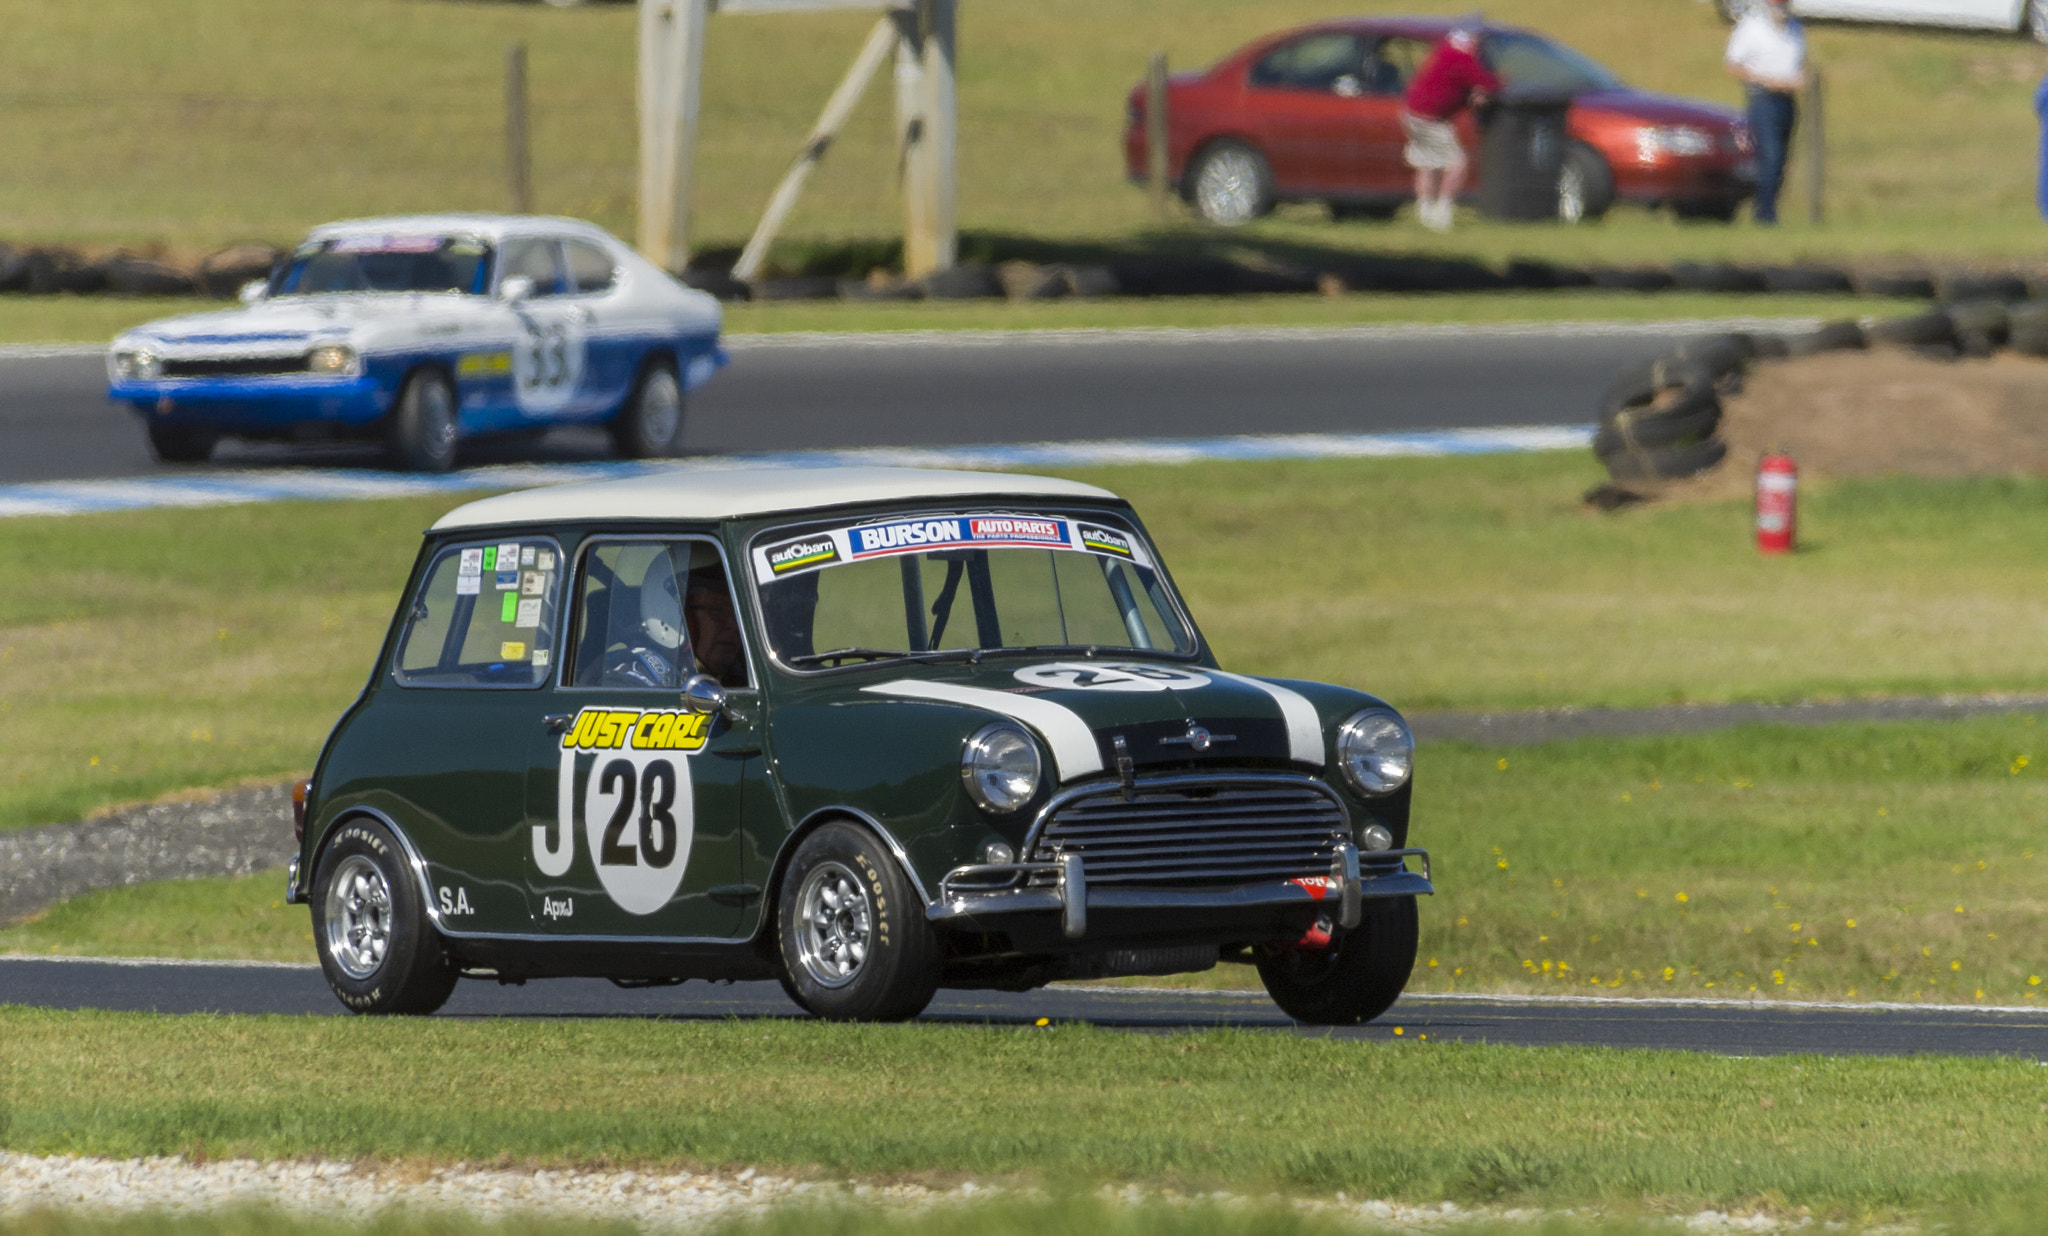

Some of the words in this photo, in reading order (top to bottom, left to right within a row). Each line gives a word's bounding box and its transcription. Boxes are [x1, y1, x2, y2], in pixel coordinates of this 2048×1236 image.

[860, 521, 960, 550] BURSON
[977, 520, 1013, 533] AUTO
[1013, 521, 1055, 535] PARTS
[562, 711, 640, 748] JUST
[631, 712, 714, 749] CARS
[532, 749, 576, 877] J
[599, 758, 677, 869] 28
[1297, 877, 1326, 887] TOW
[439, 886, 475, 915] S.A.
